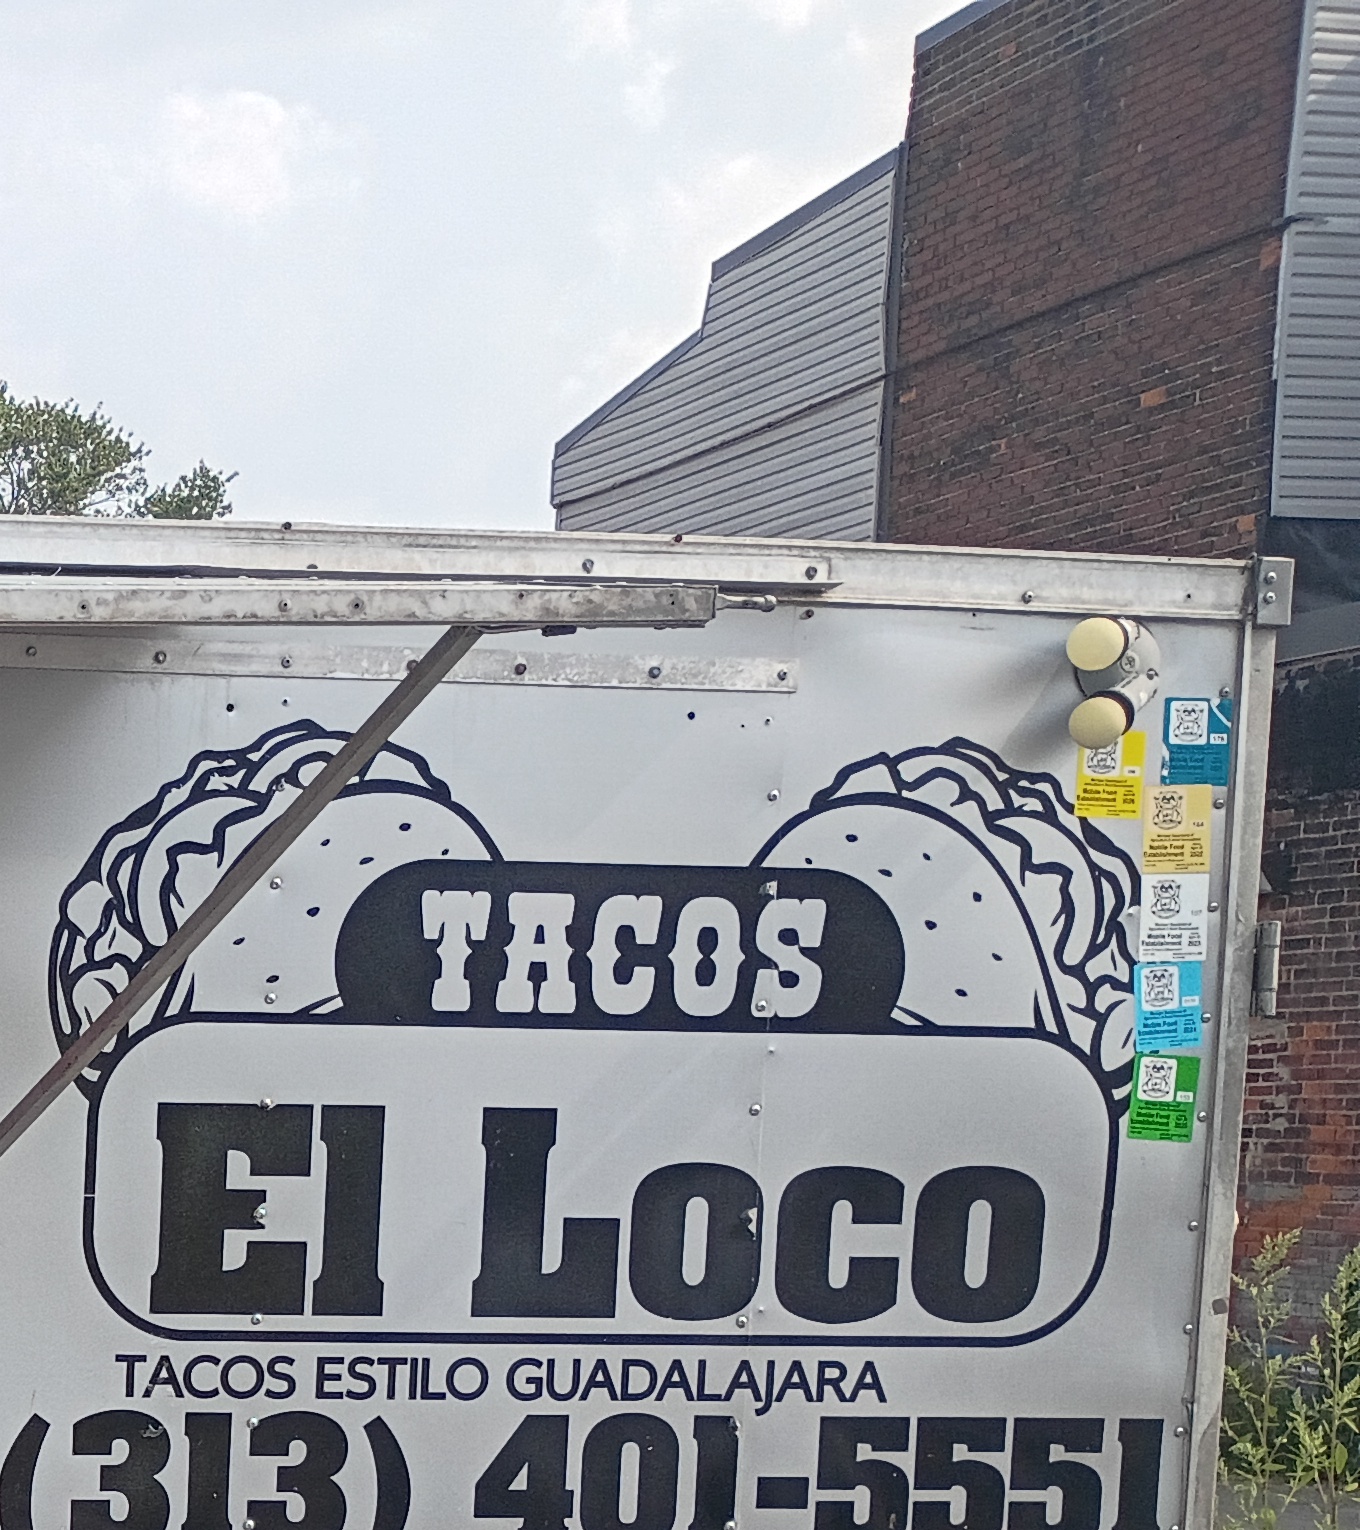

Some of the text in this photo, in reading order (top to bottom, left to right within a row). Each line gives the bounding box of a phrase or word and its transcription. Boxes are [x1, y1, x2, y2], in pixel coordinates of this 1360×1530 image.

[422, 889, 828, 1018] TACOS
[149, 1102, 1046, 1324] El Loco
[114, 1353, 887, 1416] TACOS ESTILO GUADALAJARA
